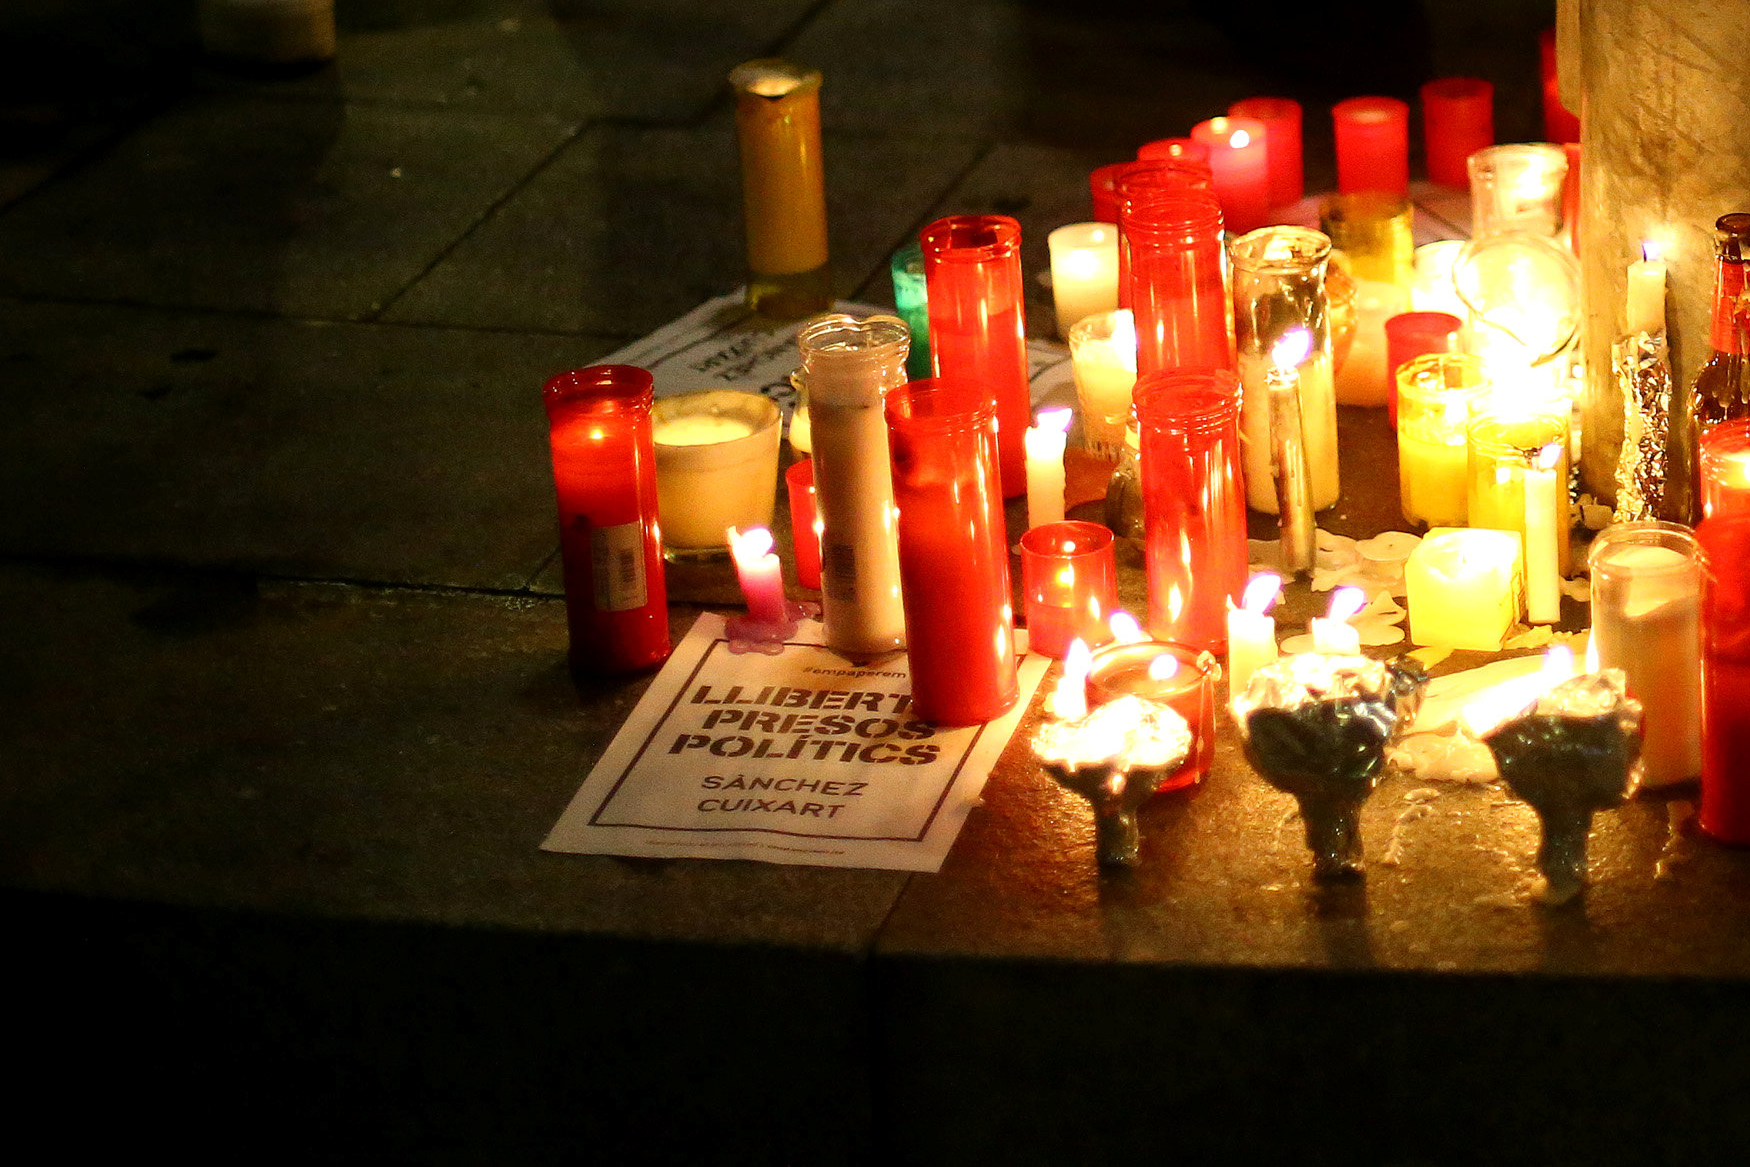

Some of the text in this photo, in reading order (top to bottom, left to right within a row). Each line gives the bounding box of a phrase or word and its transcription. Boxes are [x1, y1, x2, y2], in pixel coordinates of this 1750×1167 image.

[690, 685, 912, 714] LLIBERT
[702, 709, 938, 740] PRESOS
[667, 734, 940, 765] POLÍTICS
[697, 798, 845, 819] CUIXART
